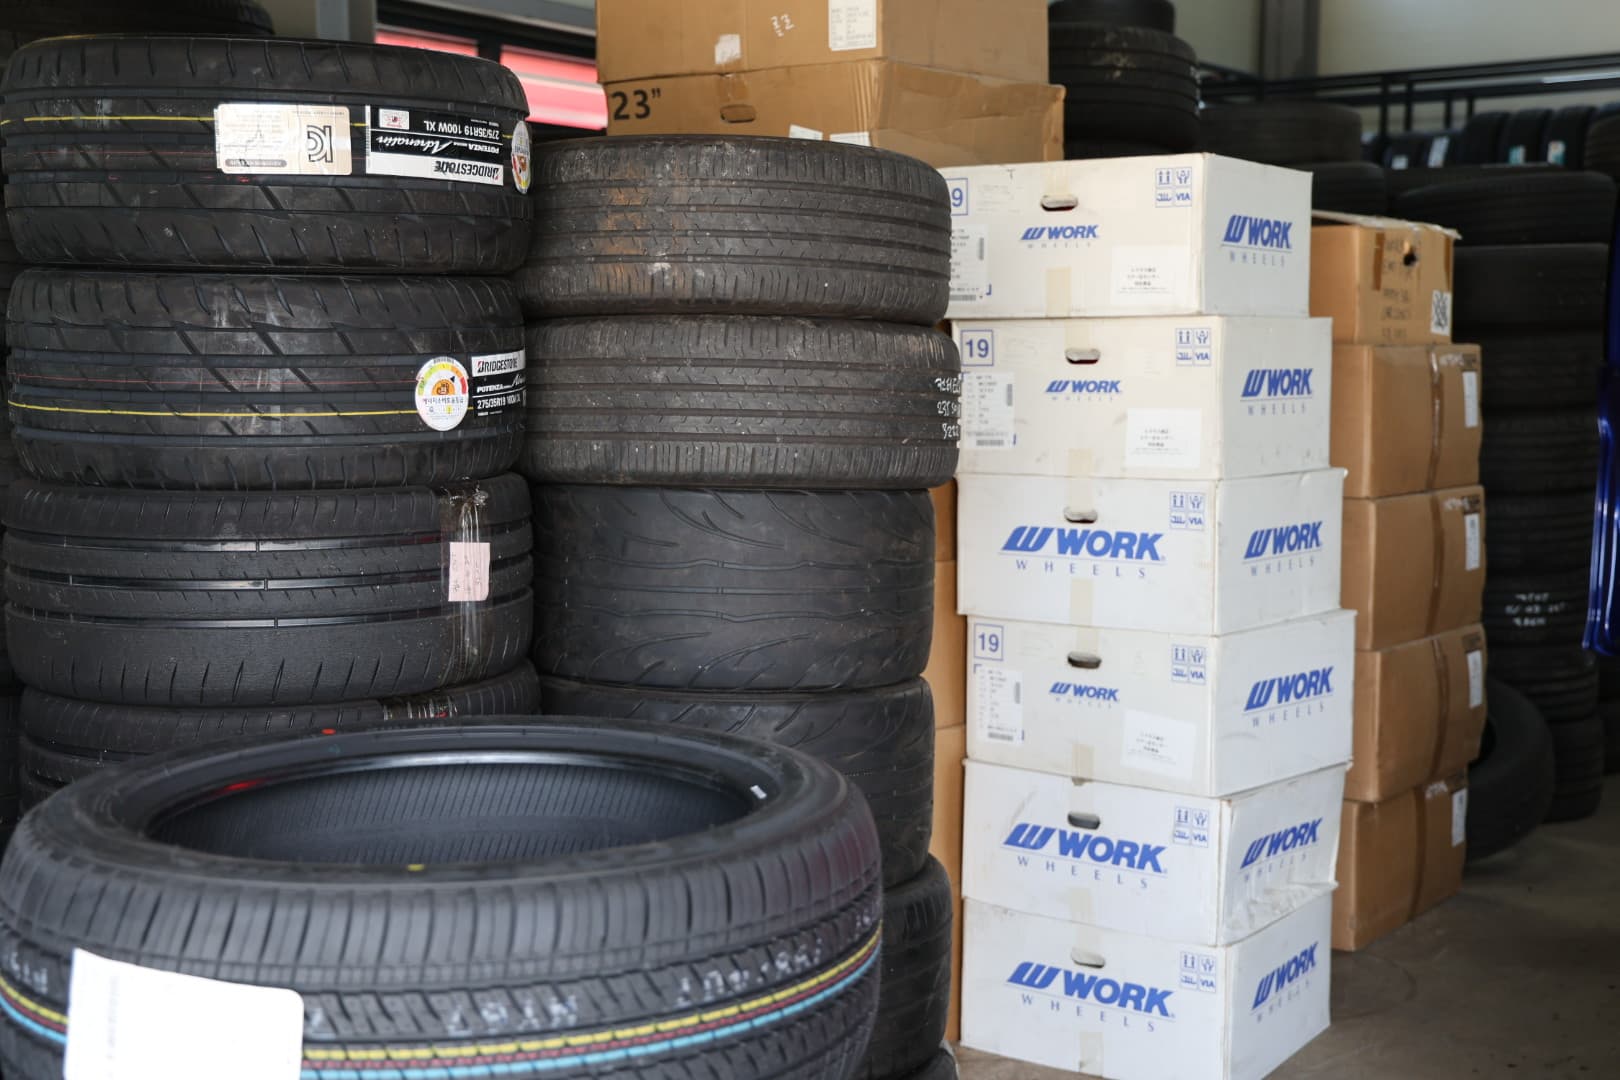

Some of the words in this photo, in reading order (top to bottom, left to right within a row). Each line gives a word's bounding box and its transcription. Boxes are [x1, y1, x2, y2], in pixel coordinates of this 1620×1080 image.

[611, 87, 661, 120] 23"
[424, 120, 438, 131] XL
[438, 122, 463, 134] 100W
[464, 128, 500, 140] 275/35R19
[375, 135, 453, 155] Adrenalin
[468, 143, 500, 154] POTENZA
[433, 160, 500, 181] BRIDGESTONE
[951, 187, 963, 207] 9
[1047, 225, 1098, 240] WORK
[1248, 217, 1292, 249] WORK
[965, 338, 990, 358] 19
[477, 358, 518, 373] BRIDGESTONE
[1071, 379, 1121, 393] WORK
[1267, 368, 1313, 397] WORK
[1057, 528, 1164, 561] WORK
[1272, 521, 1323, 555] WORK
[1016, 559, 1146, 578] WHEELS
[977, 631, 1000, 653] 19
[1072, 684, 1119, 702] WORK
[1277, 665, 1334, 704] WORK
[1266, 817, 1323, 857] WORK
[1058, 829, 1167, 873] WORK
[1017, 855, 1148, 889] WHEELS
[1275, 941, 1319, 993] WORK
[1063, 969, 1175, 1017] WORK
[1022, 993, 1154, 1032] WHEELS
